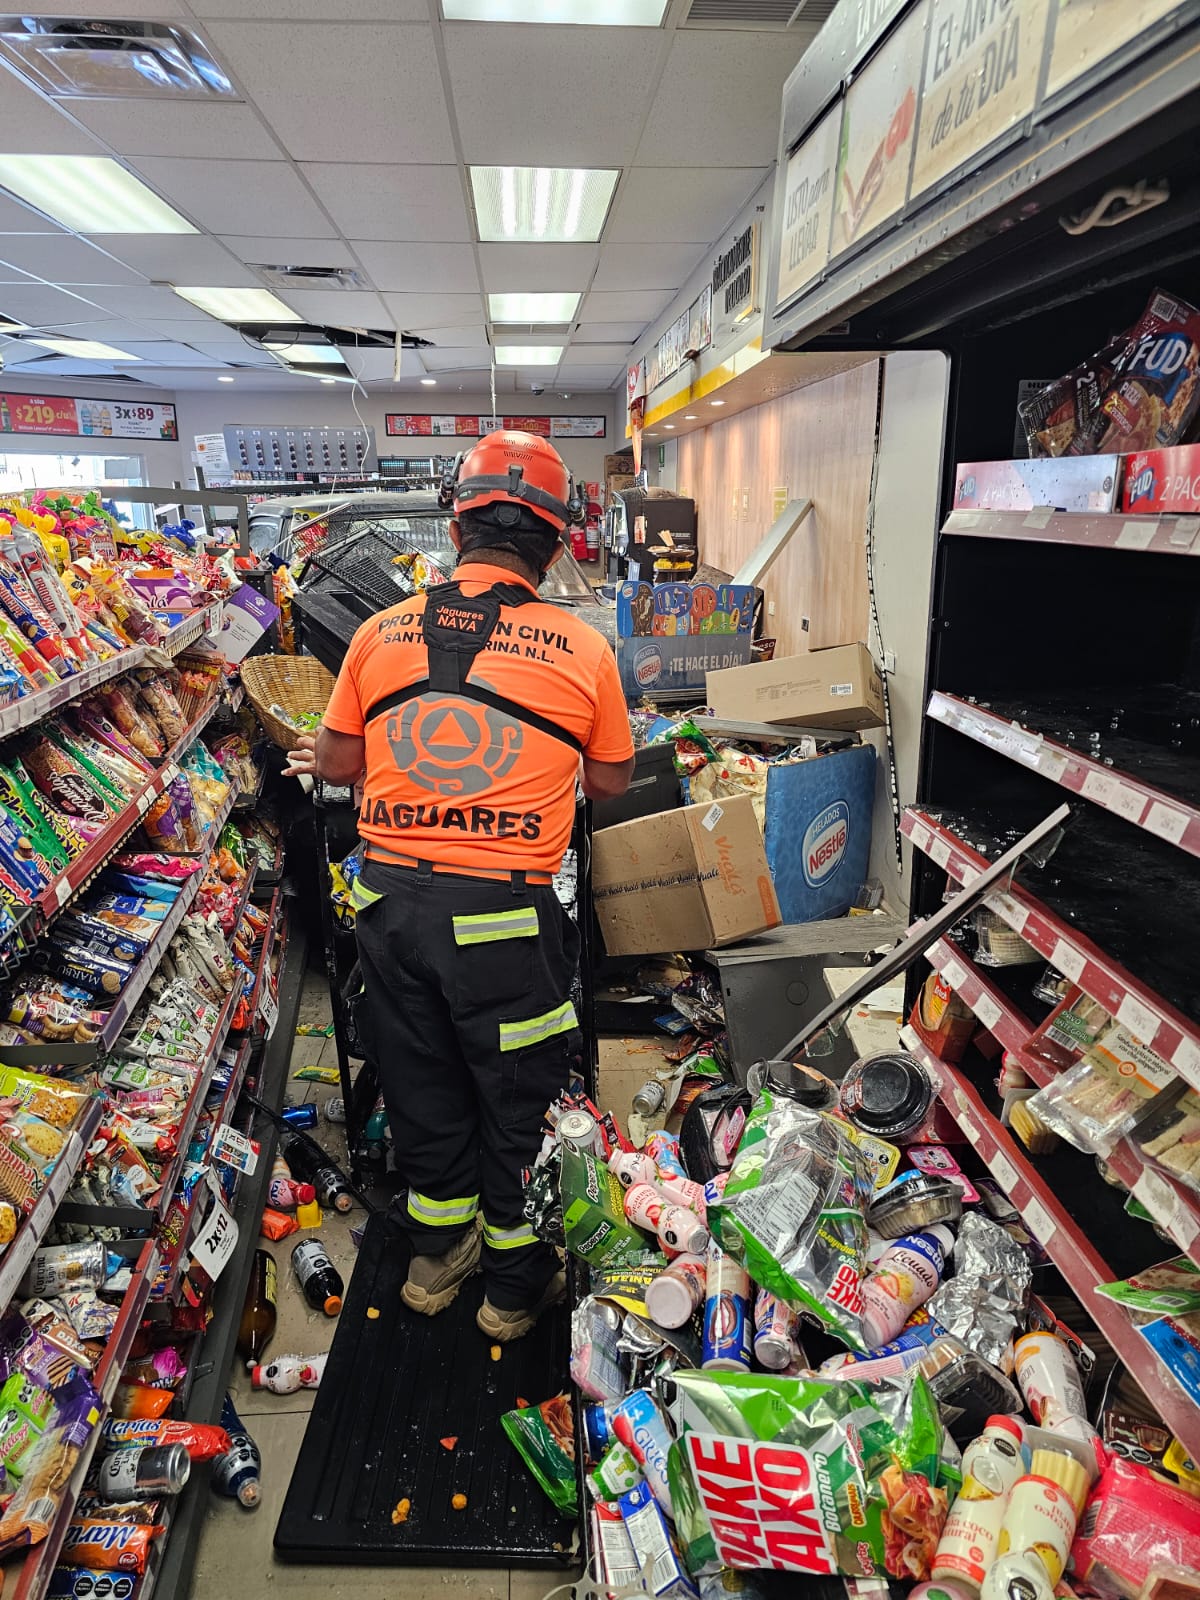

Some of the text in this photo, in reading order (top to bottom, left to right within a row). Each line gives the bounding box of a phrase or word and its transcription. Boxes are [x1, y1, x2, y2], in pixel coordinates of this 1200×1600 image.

[1128, 337, 1188, 375] FUD
[436, 605, 485, 622] Jaguares
[437, 615, 477, 633] NAVA
[384, 631, 427, 645] SANT
[524, 647, 555, 664] N.L.
[517, 625, 575, 656] CIVIL
[685, 655, 709, 672] HACE
[710, 655, 720, 669] EL
[360, 798, 543, 841] JAGUARES
[811, 807, 840, 838] HELADOS
[808, 825, 846, 875] Nestlé
[814, 1452, 842, 1533] Botanero
[754, 1446, 832, 1575] AXO
